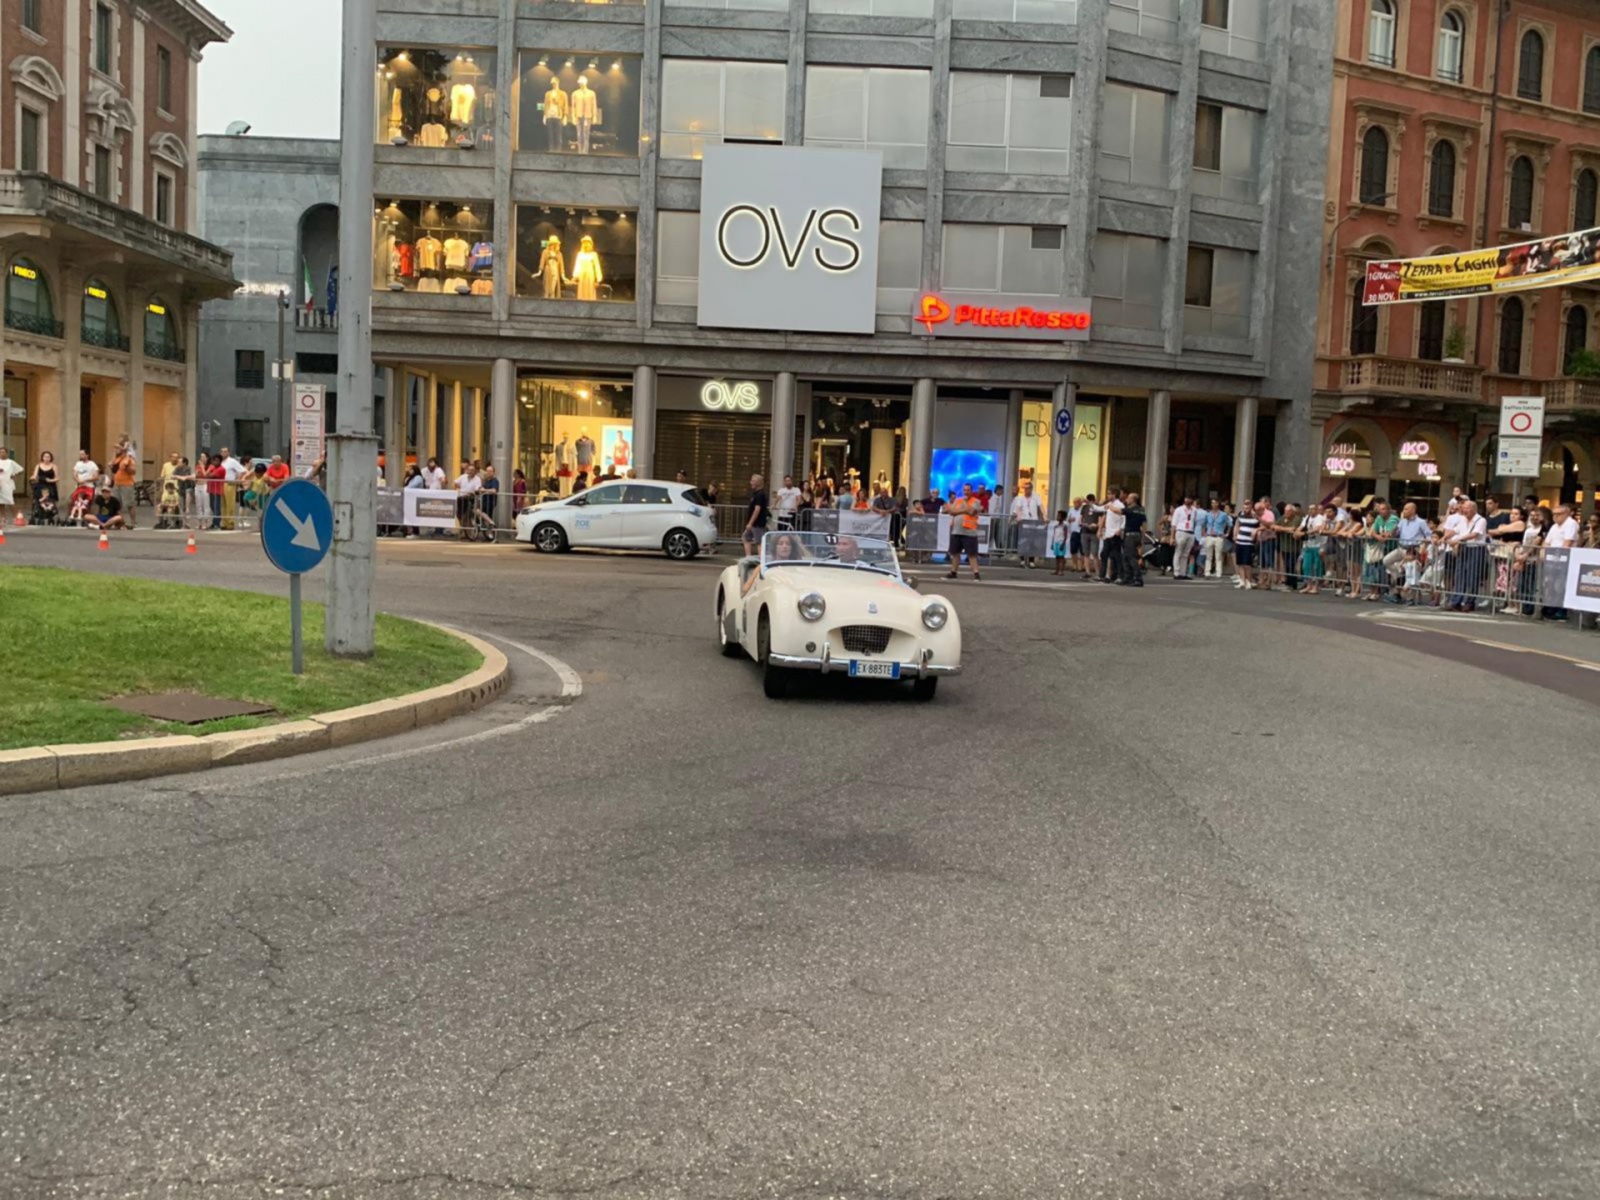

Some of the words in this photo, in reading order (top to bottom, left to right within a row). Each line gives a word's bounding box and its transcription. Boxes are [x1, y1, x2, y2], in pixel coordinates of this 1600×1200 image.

[717, 204, 863, 273] OVS
[1402, 262, 1443, 278] TERRA
[1454, 256, 1497, 273] LAGHI
[954, 304, 1091, 331] PittaRosso
[701, 379, 761, 411] OVS
[1025, 419, 1097, 441] DOAS
[825, 535, 837, 543] 11
[857, 663, 867, 674] EX
